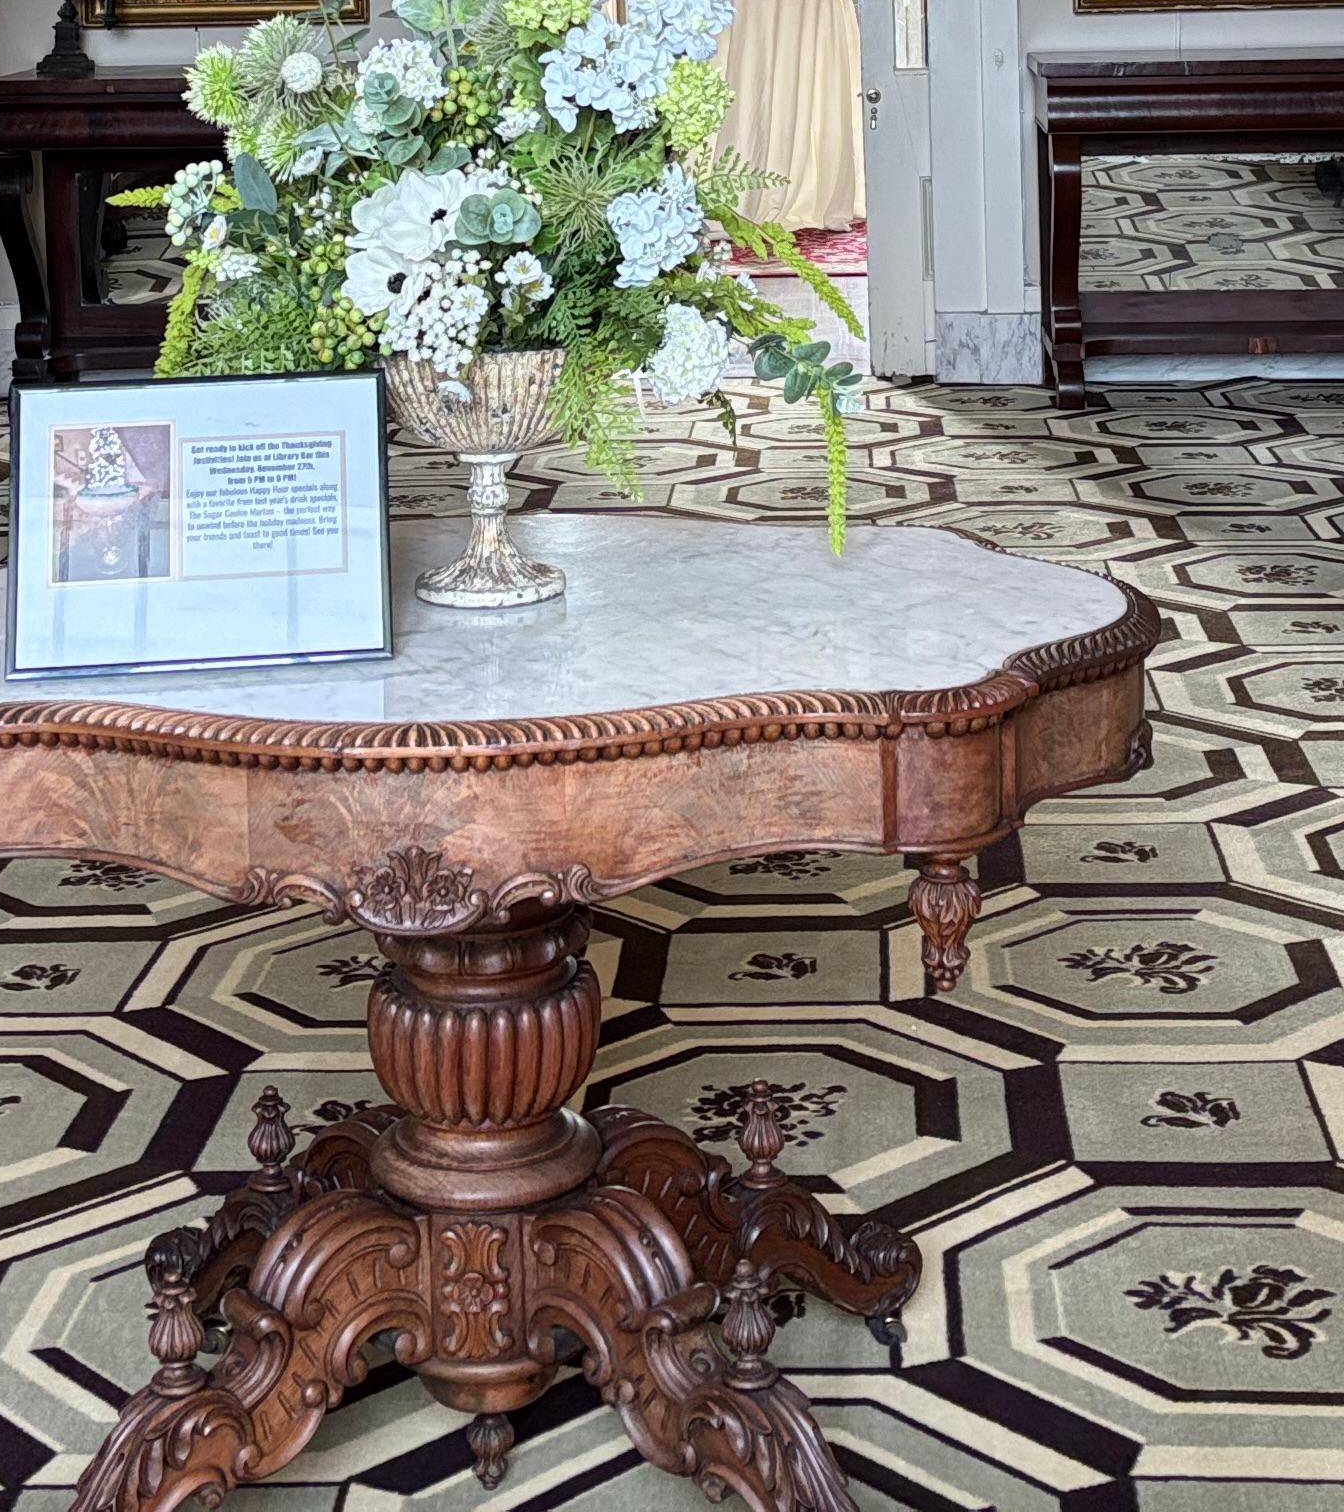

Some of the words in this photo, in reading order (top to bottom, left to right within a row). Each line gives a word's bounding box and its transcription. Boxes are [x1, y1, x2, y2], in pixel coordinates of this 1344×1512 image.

[206, 445, 227, 453] ready
[282, 440, 331, 449] Thanksgiving
[301, 451, 313, 459] Bar
[283, 473, 296, 482] PM!
[187, 489, 204, 498] Enjoy
[220, 488, 248, 496] fabulous
[250, 487, 270, 495] Happy
[273, 485, 289, 493] Hour
[291, 483, 317, 492] specials
[209, 499, 234, 507] favorite
[255, 497, 267, 505] last
[290, 495, 307, 503] drink
[190, 511, 201, 519] The
[203, 511, 222, 520] Sugar
[225, 509, 248, 517] Cookie
[284, 506, 294, 514] the
[297, 505, 320, 515] perfect
[188, 523, 194, 531] to
[260, 518, 283, 527] holiday
[319, 514, 337, 524] Bring
[203, 531, 227, 541] friends
[229, 531, 241, 540] and
[243, 530, 260, 538] toast
[271, 528, 288, 538] good
[312, 527, 324, 535] See
[327, 528, 338, 536] you
